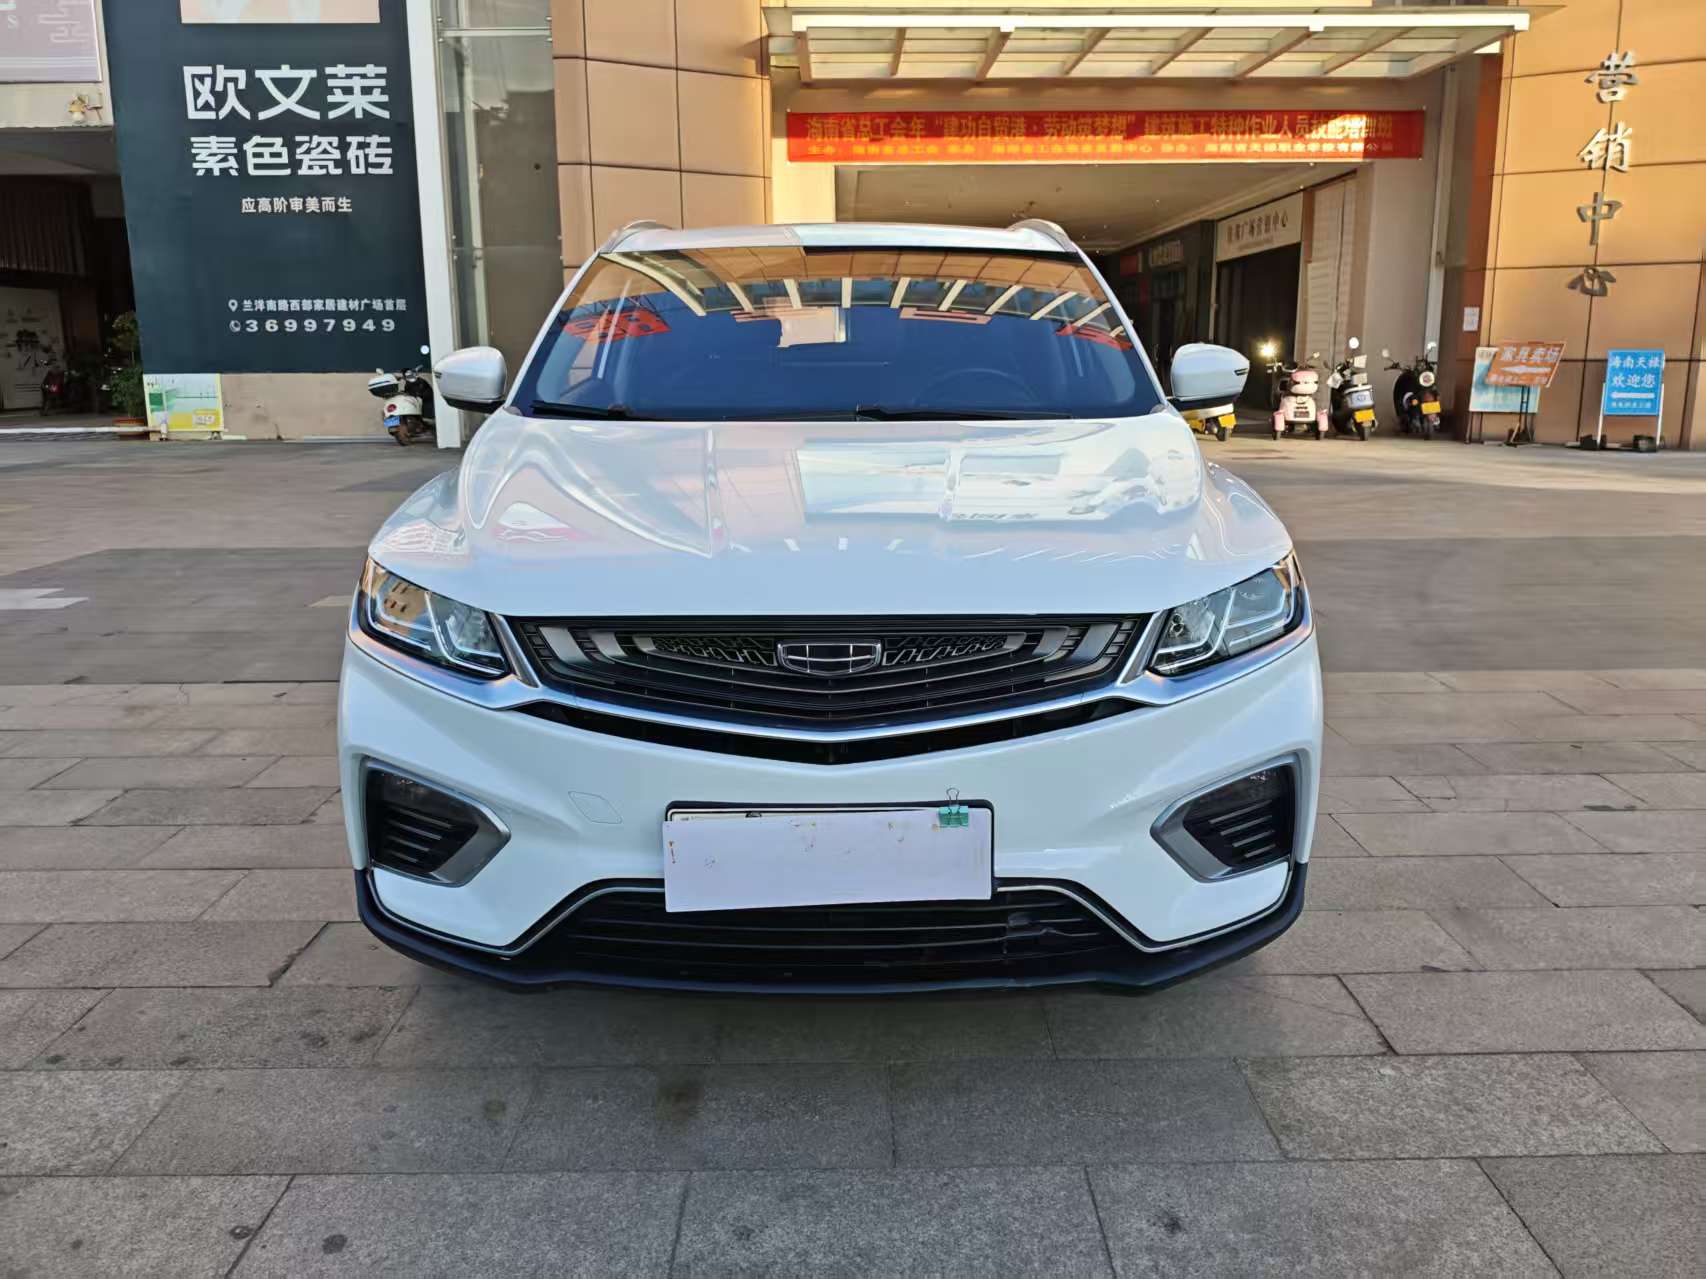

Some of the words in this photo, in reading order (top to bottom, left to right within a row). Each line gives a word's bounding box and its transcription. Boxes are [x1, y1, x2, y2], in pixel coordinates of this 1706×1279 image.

[183, 64, 391, 121] 欧文莱
[190, 134, 394, 177] 素色瓷砖
[1568, 50, 1641, 298] 营销中心
[240, 196, 353, 214] 应高阶审美而生
[242, 298, 407, 312] 兰洋南路西部家居建材广场首层
[245, 318, 396, 333] 36997949
[1612, 373, 1656, 388] 欢迎您
